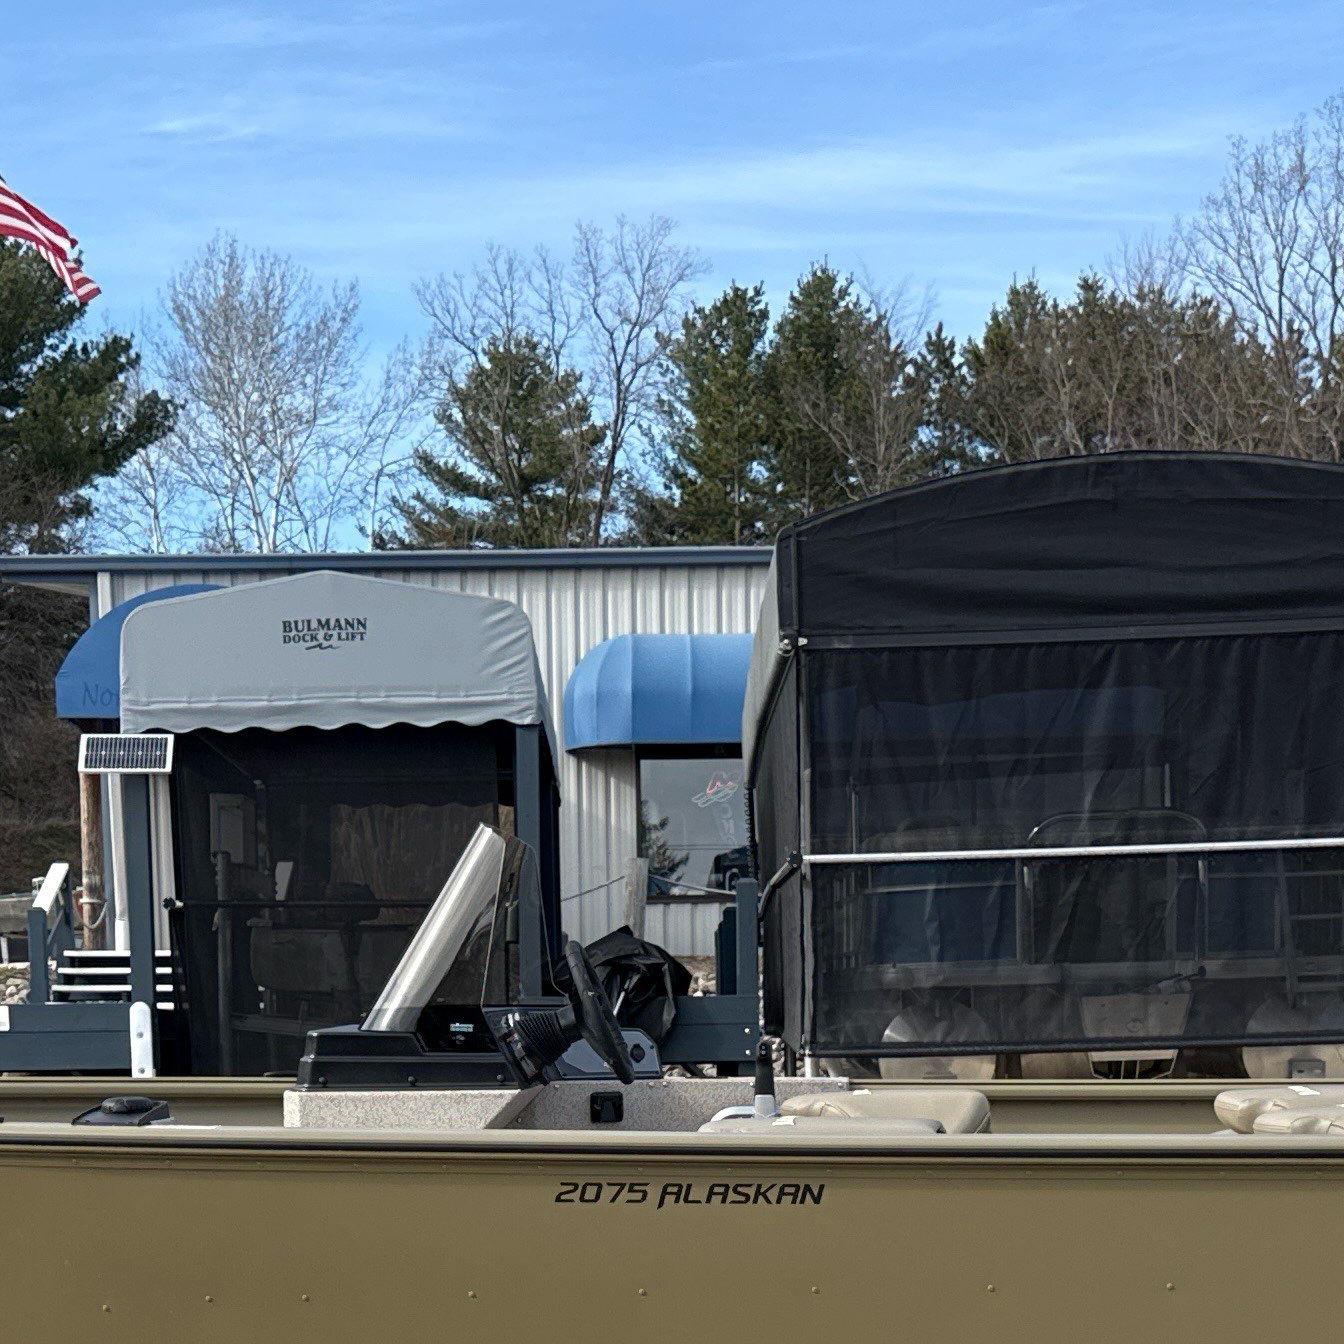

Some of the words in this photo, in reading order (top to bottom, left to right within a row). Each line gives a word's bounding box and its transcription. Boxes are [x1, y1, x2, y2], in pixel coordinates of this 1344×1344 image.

[282, 617, 367, 633] BULMANN
[283, 633, 319, 644] DOCK
[323, 632, 333, 642] &
[338, 632, 366, 641] LIFT
[555, 1182, 650, 1204] 2075
[656, 1183, 826, 1211] ALASKAN
